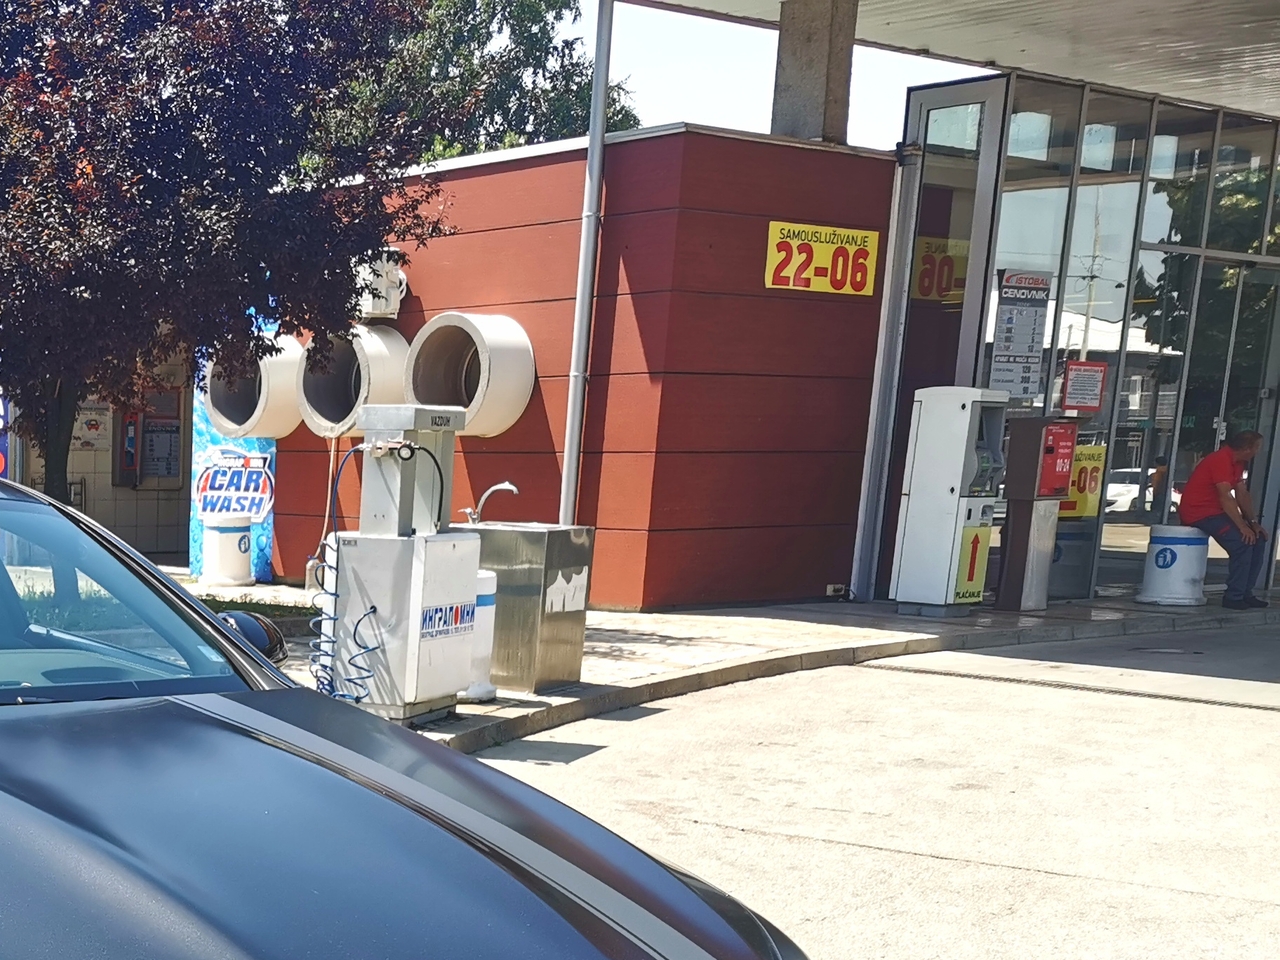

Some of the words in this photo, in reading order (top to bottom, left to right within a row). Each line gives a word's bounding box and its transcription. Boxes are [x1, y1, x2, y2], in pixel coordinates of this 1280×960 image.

[778, 227, 870, 248] SAMOUSLUŽIVANJE
[771, 240, 870, 292] 22-06
[1015, 276, 1050, 287] ISTOBAL
[1001, 287, 1048, 300] CENOVNIK
[209, 469, 264, 493] CAR
[201, 494, 265, 515] WASH
